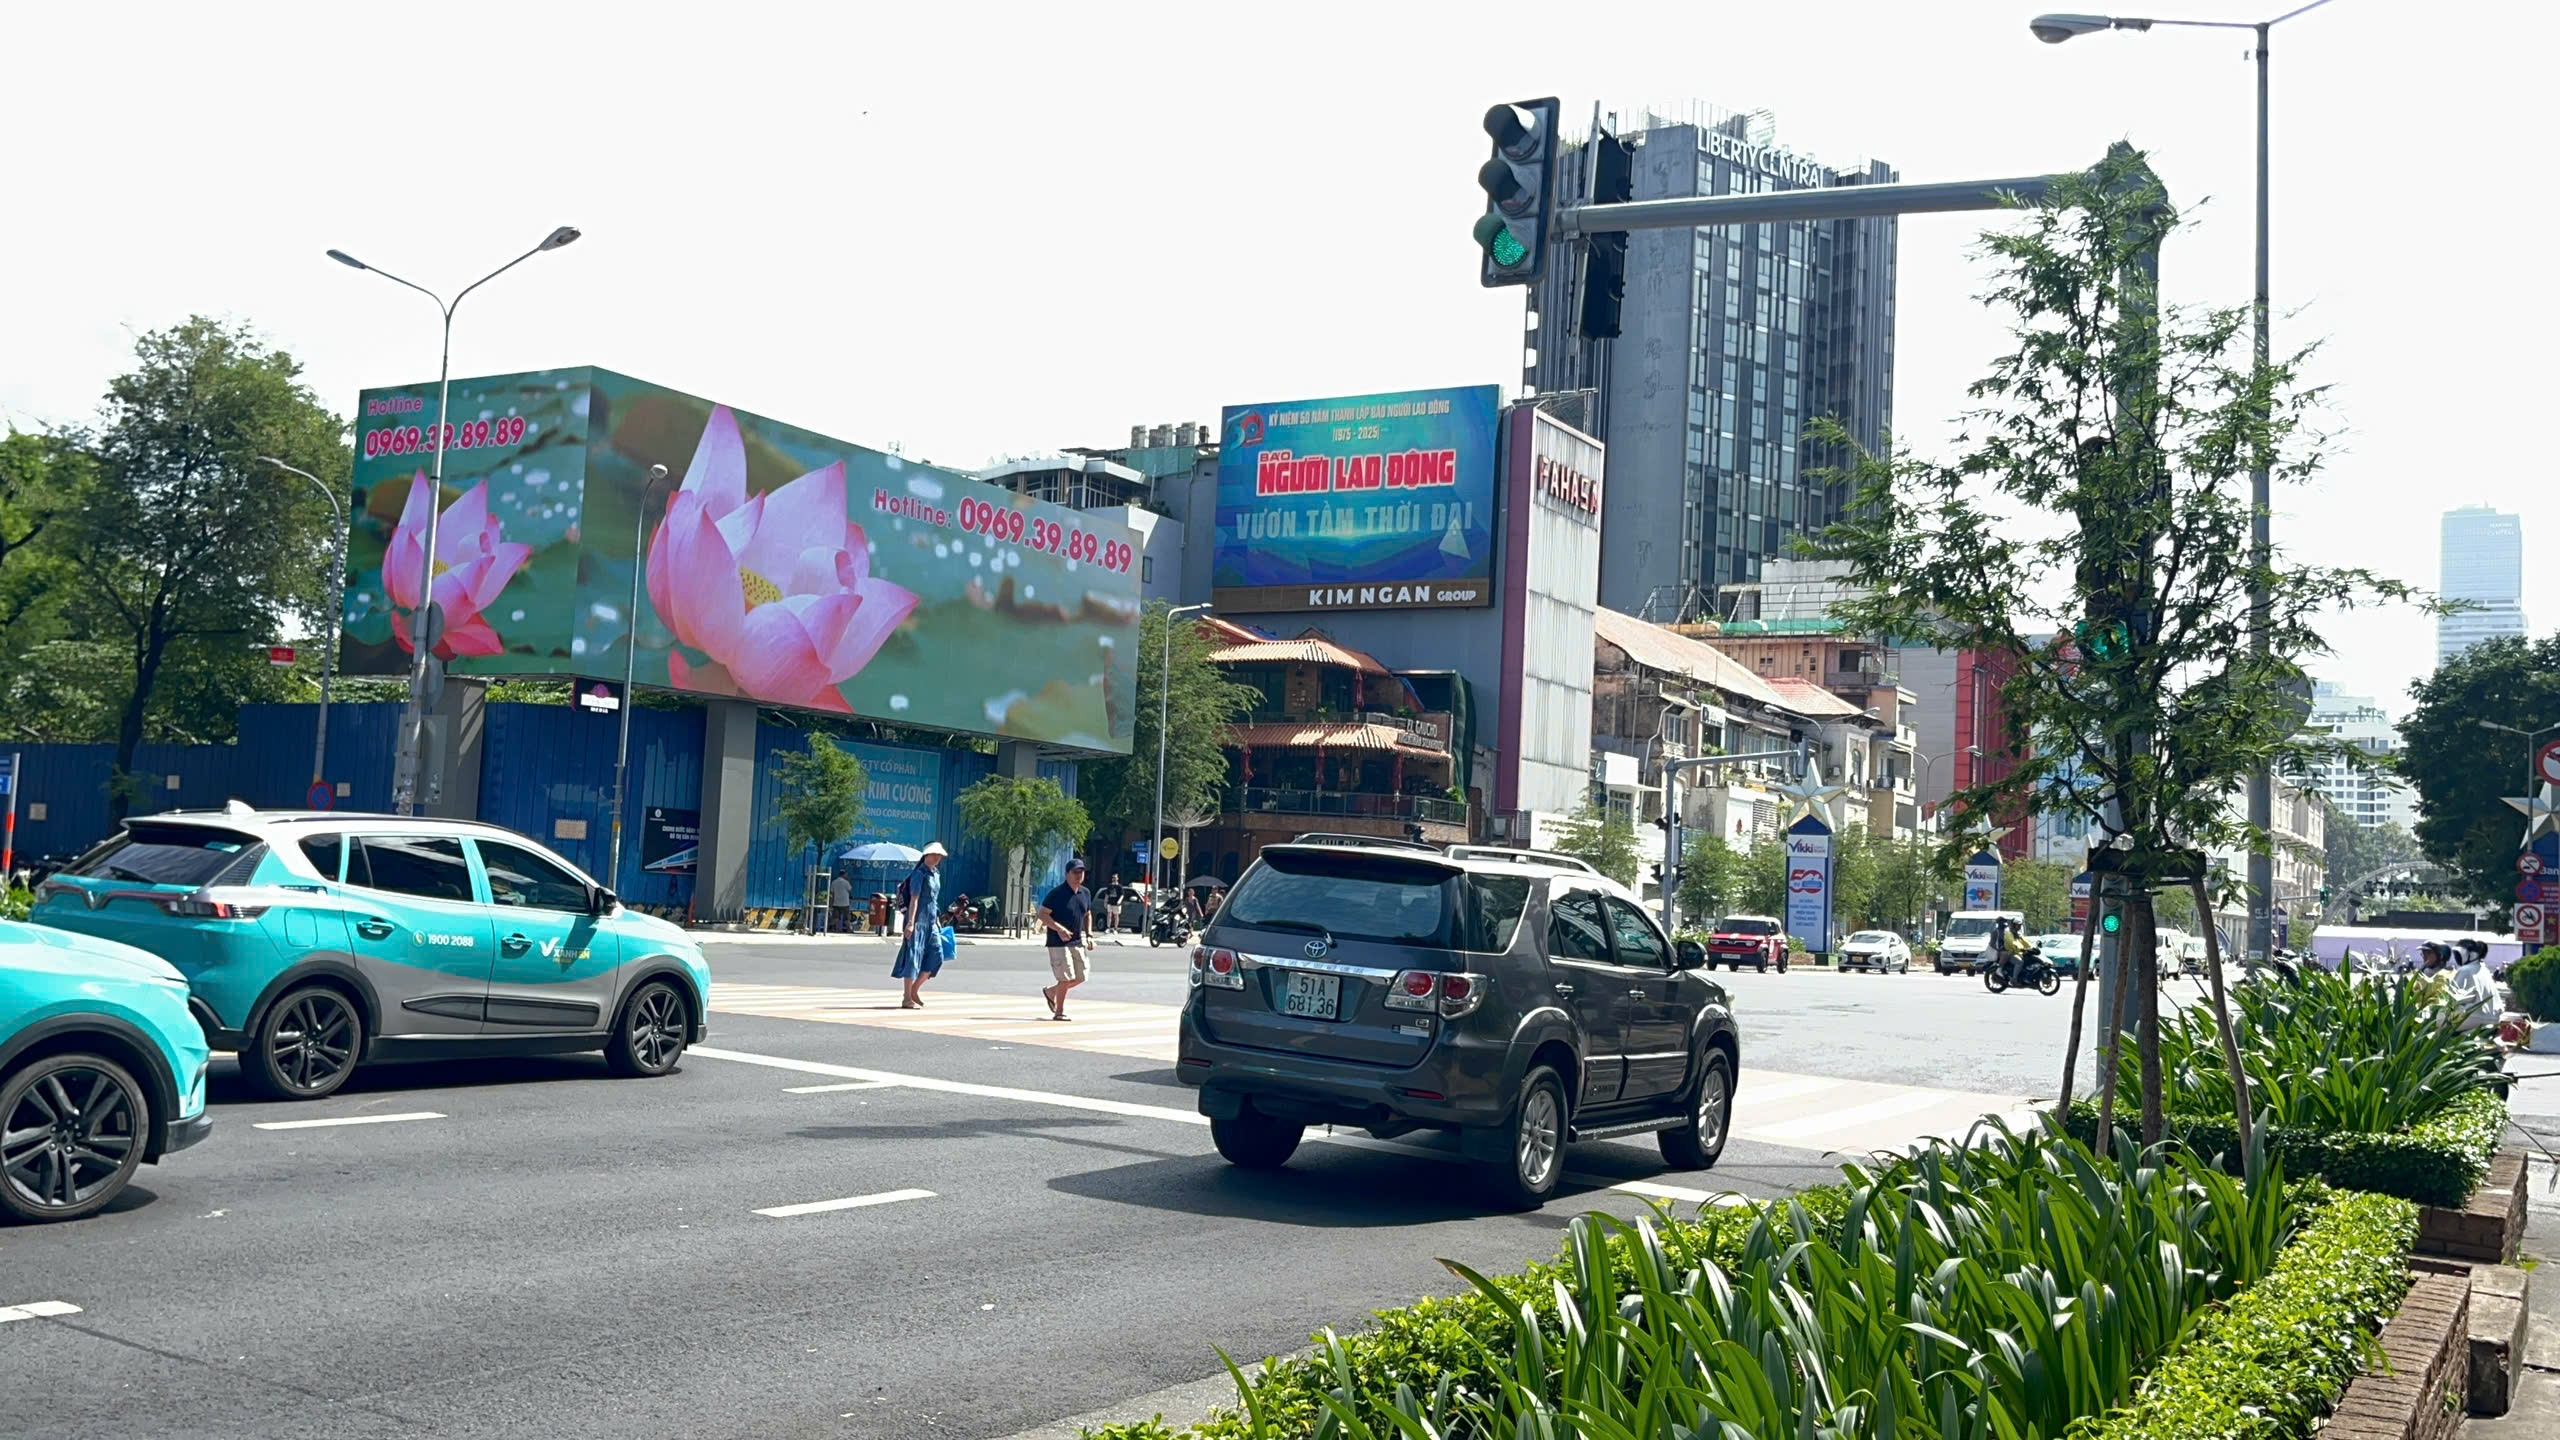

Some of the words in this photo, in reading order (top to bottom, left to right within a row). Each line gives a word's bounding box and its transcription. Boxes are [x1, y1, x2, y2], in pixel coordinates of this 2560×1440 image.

[1697, 127, 1758, 168] LIBERTY
[367, 397, 423, 416] Hotline
[1412, 402, 1426, 415] LAO
[1427, 399, 1450, 416] ĐỘNG
[366, 416, 526, 457] 0969.39.89.89
[1257, 455, 1330, 494] NGƯỜI
[1335, 455, 1381, 490] LAO
[1386, 450, 1456, 489] ĐỘNG
[1537, 454, 1600, 515] FAHASA
[874, 487, 953, 528] Hotline:
[959, 497, 1133, 574] 0969.39.89.89
[1236, 507, 1297, 540] VƯƠN
[1306, 500, 1354, 537] TẦM
[1364, 501, 1421, 536] THỜI
[1431, 501, 1473, 536] ĐẠI
[1309, 588, 1354, 606] KIM
[1360, 585, 1430, 604] NGAN
[1436, 590, 1477, 602] GROUP
[868, 780, 890, 801] KIM
[892, 781, 933, 804] CƯƠNG
[882, 808, 931, 821] CORPORATION
[1789, 839, 1814, 854] Vikki
[1967, 869, 1986, 881] Vikki
[427, 934, 449, 945] 1900
[450, 935, 474, 947] 2088
[553, 947, 577, 959] XANH
[1300, 976, 1326, 995] 51A
[1288, 994, 1334, 1016] 681.36
